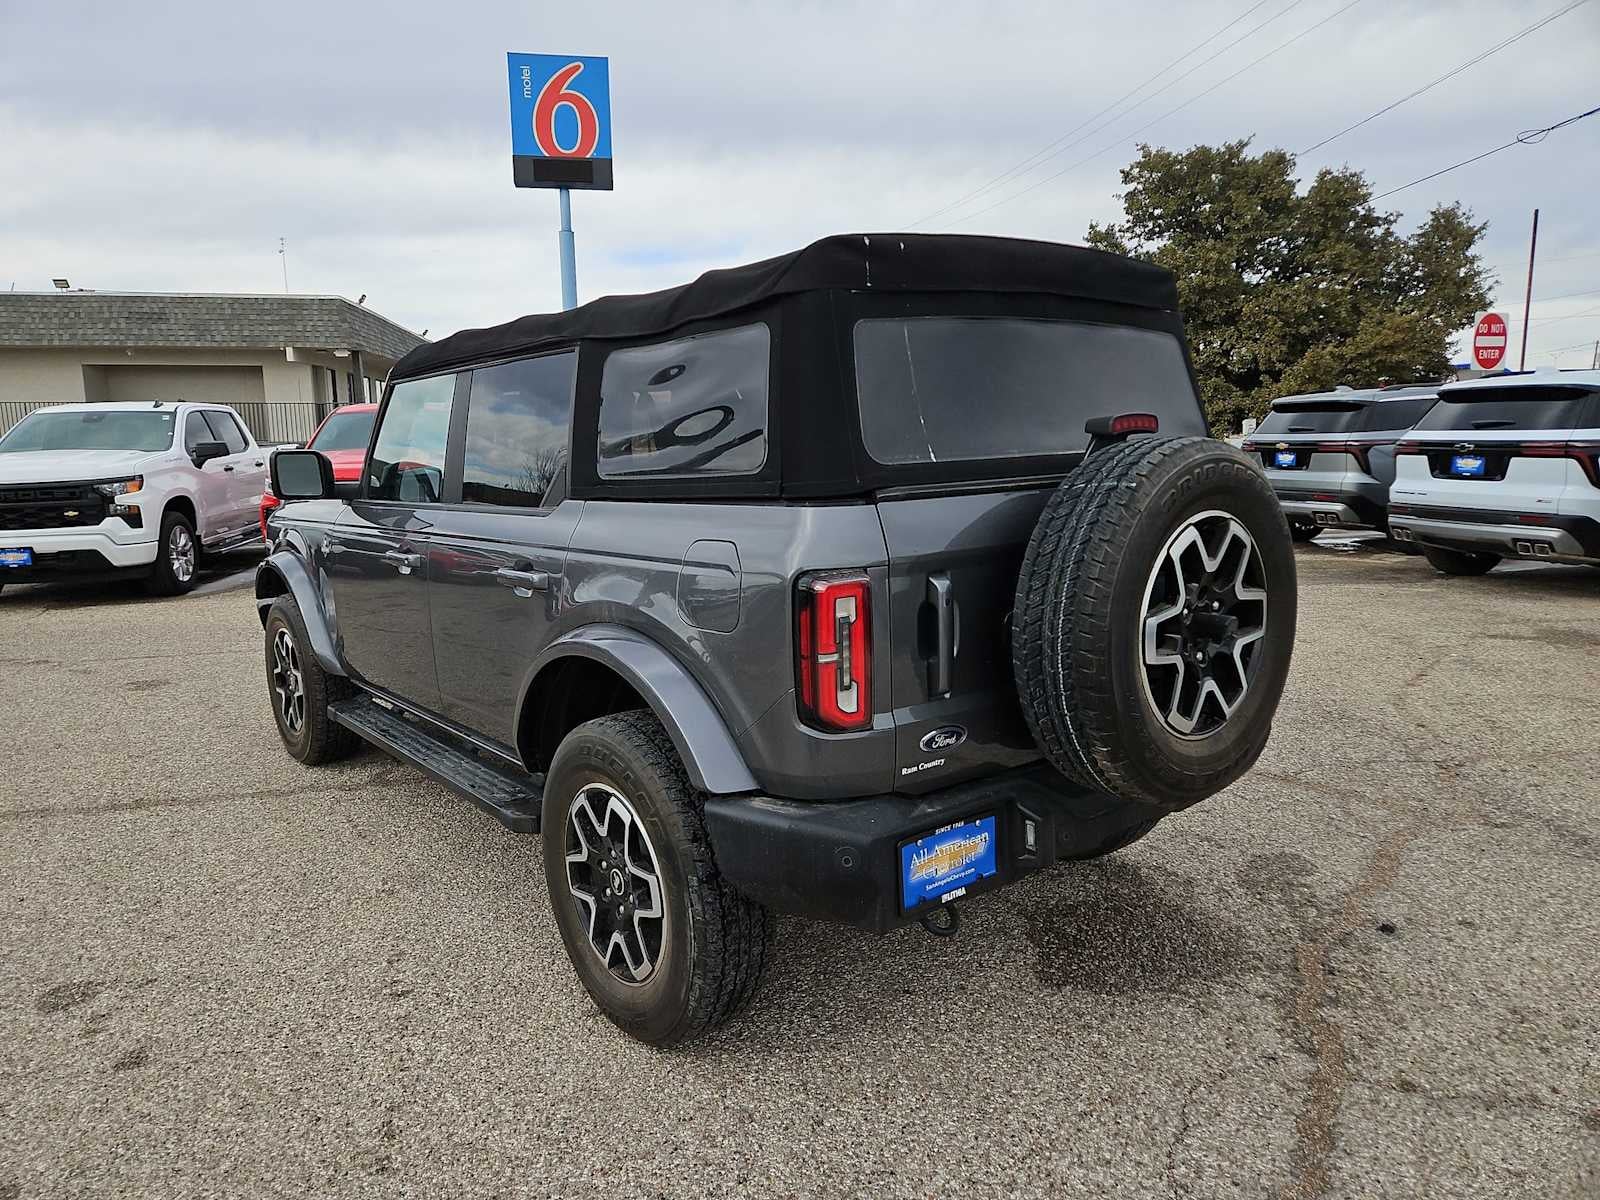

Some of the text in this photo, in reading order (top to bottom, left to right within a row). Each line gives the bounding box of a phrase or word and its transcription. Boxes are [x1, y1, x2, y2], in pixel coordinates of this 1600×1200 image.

[520, 61, 599, 158] motel 6
[1479, 323, 1504, 334] DO NOT
[1478, 349, 1500, 359] ENTER
[932, 731, 957, 750] Ford
[901, 757, 945, 776] Ram Country
[910, 830, 989, 869] All American
[922, 849, 976, 880] Chevrolet
